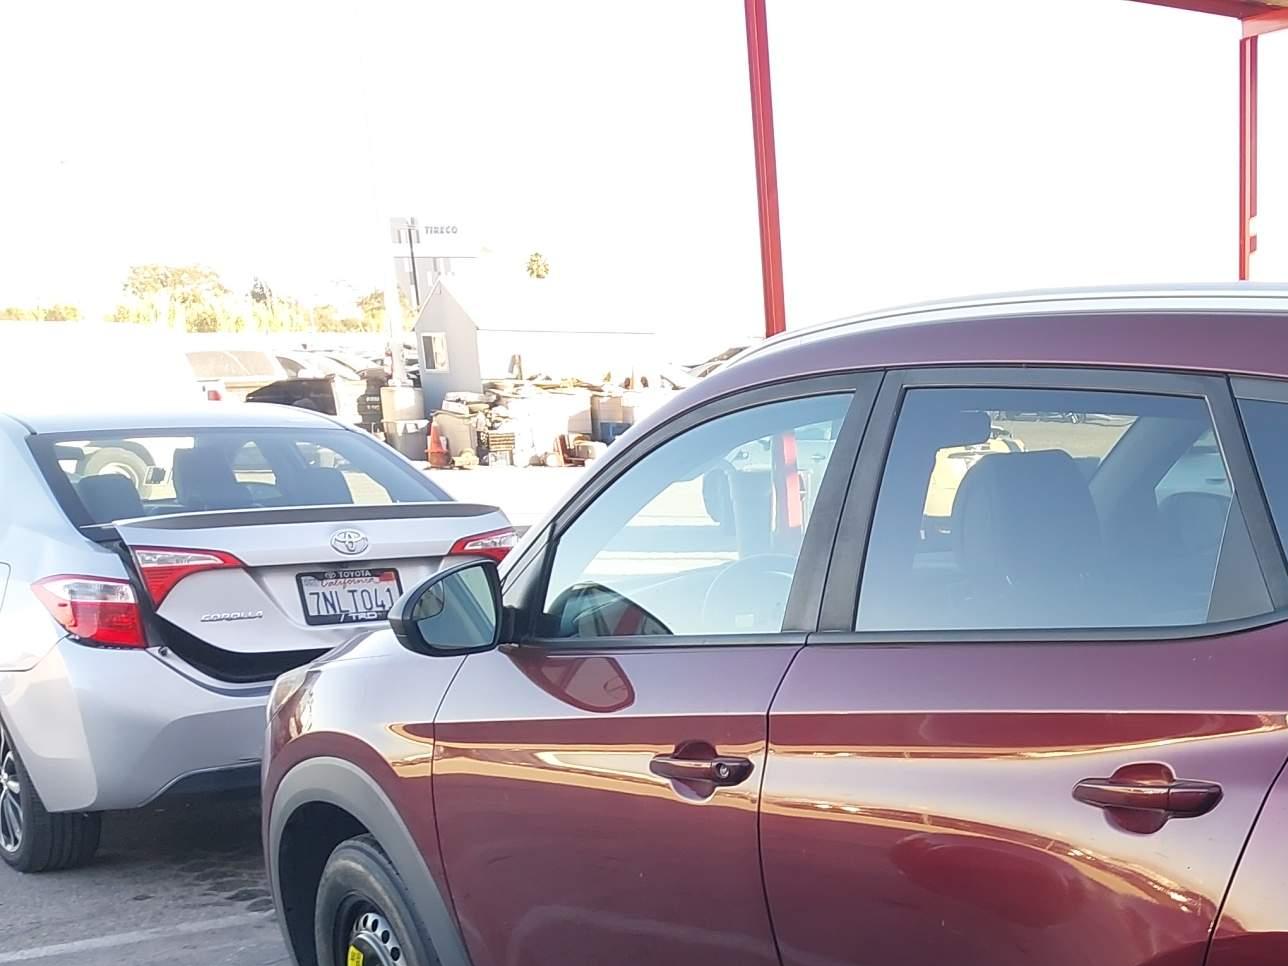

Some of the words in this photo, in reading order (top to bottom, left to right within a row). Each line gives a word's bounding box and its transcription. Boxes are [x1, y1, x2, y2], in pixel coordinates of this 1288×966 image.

[340, 570, 371, 579] TOYOTA
[320, 577, 379, 589] California
[309, 588, 394, 615] 7NLT041
[200, 610, 263, 622] COROLLA
[349, 612, 378, 621] TRD
